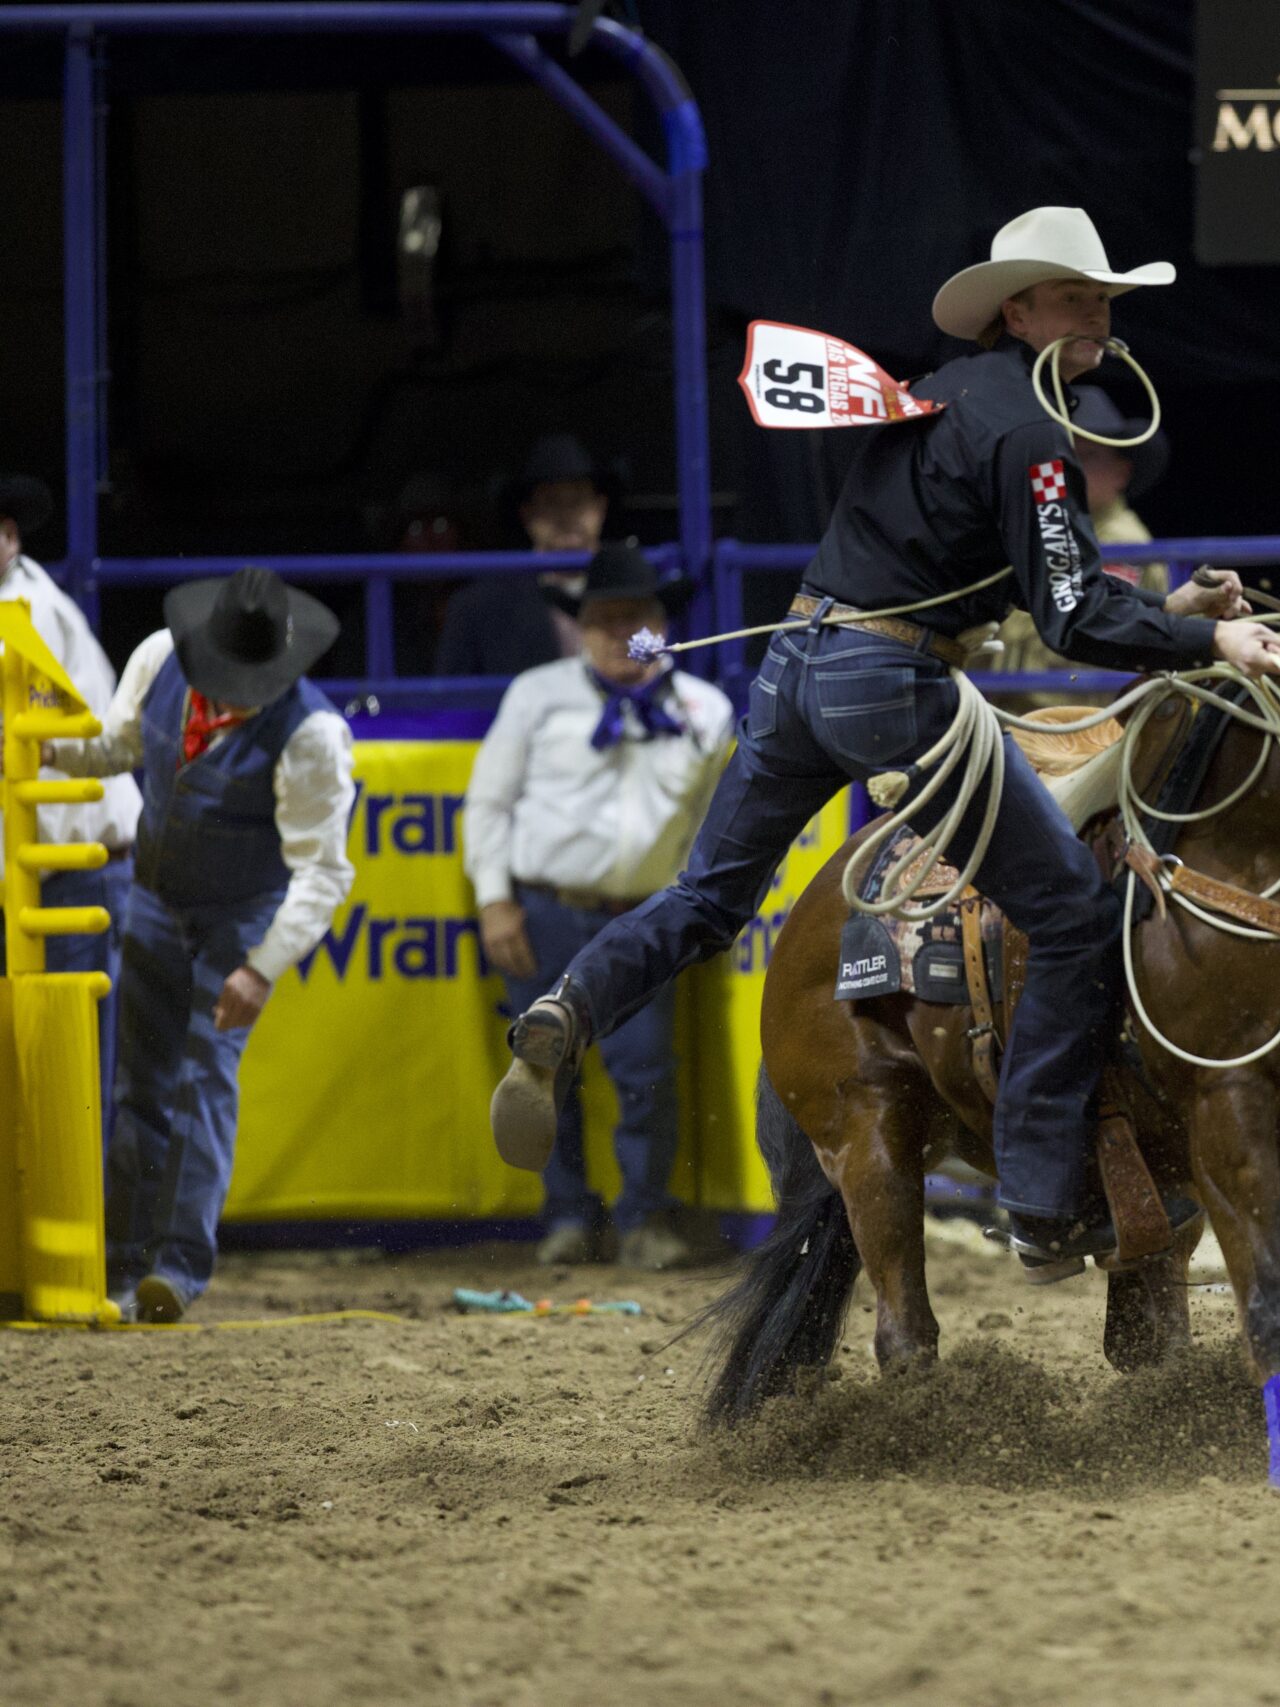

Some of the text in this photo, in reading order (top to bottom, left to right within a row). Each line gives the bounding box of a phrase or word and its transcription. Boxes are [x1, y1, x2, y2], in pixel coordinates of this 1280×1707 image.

[763, 358, 826, 414] 58
[828, 366, 850, 410] VEGAS
[1036, 502, 1077, 613] GROGAN'S
[843, 955, 886, 977] RATTLER
